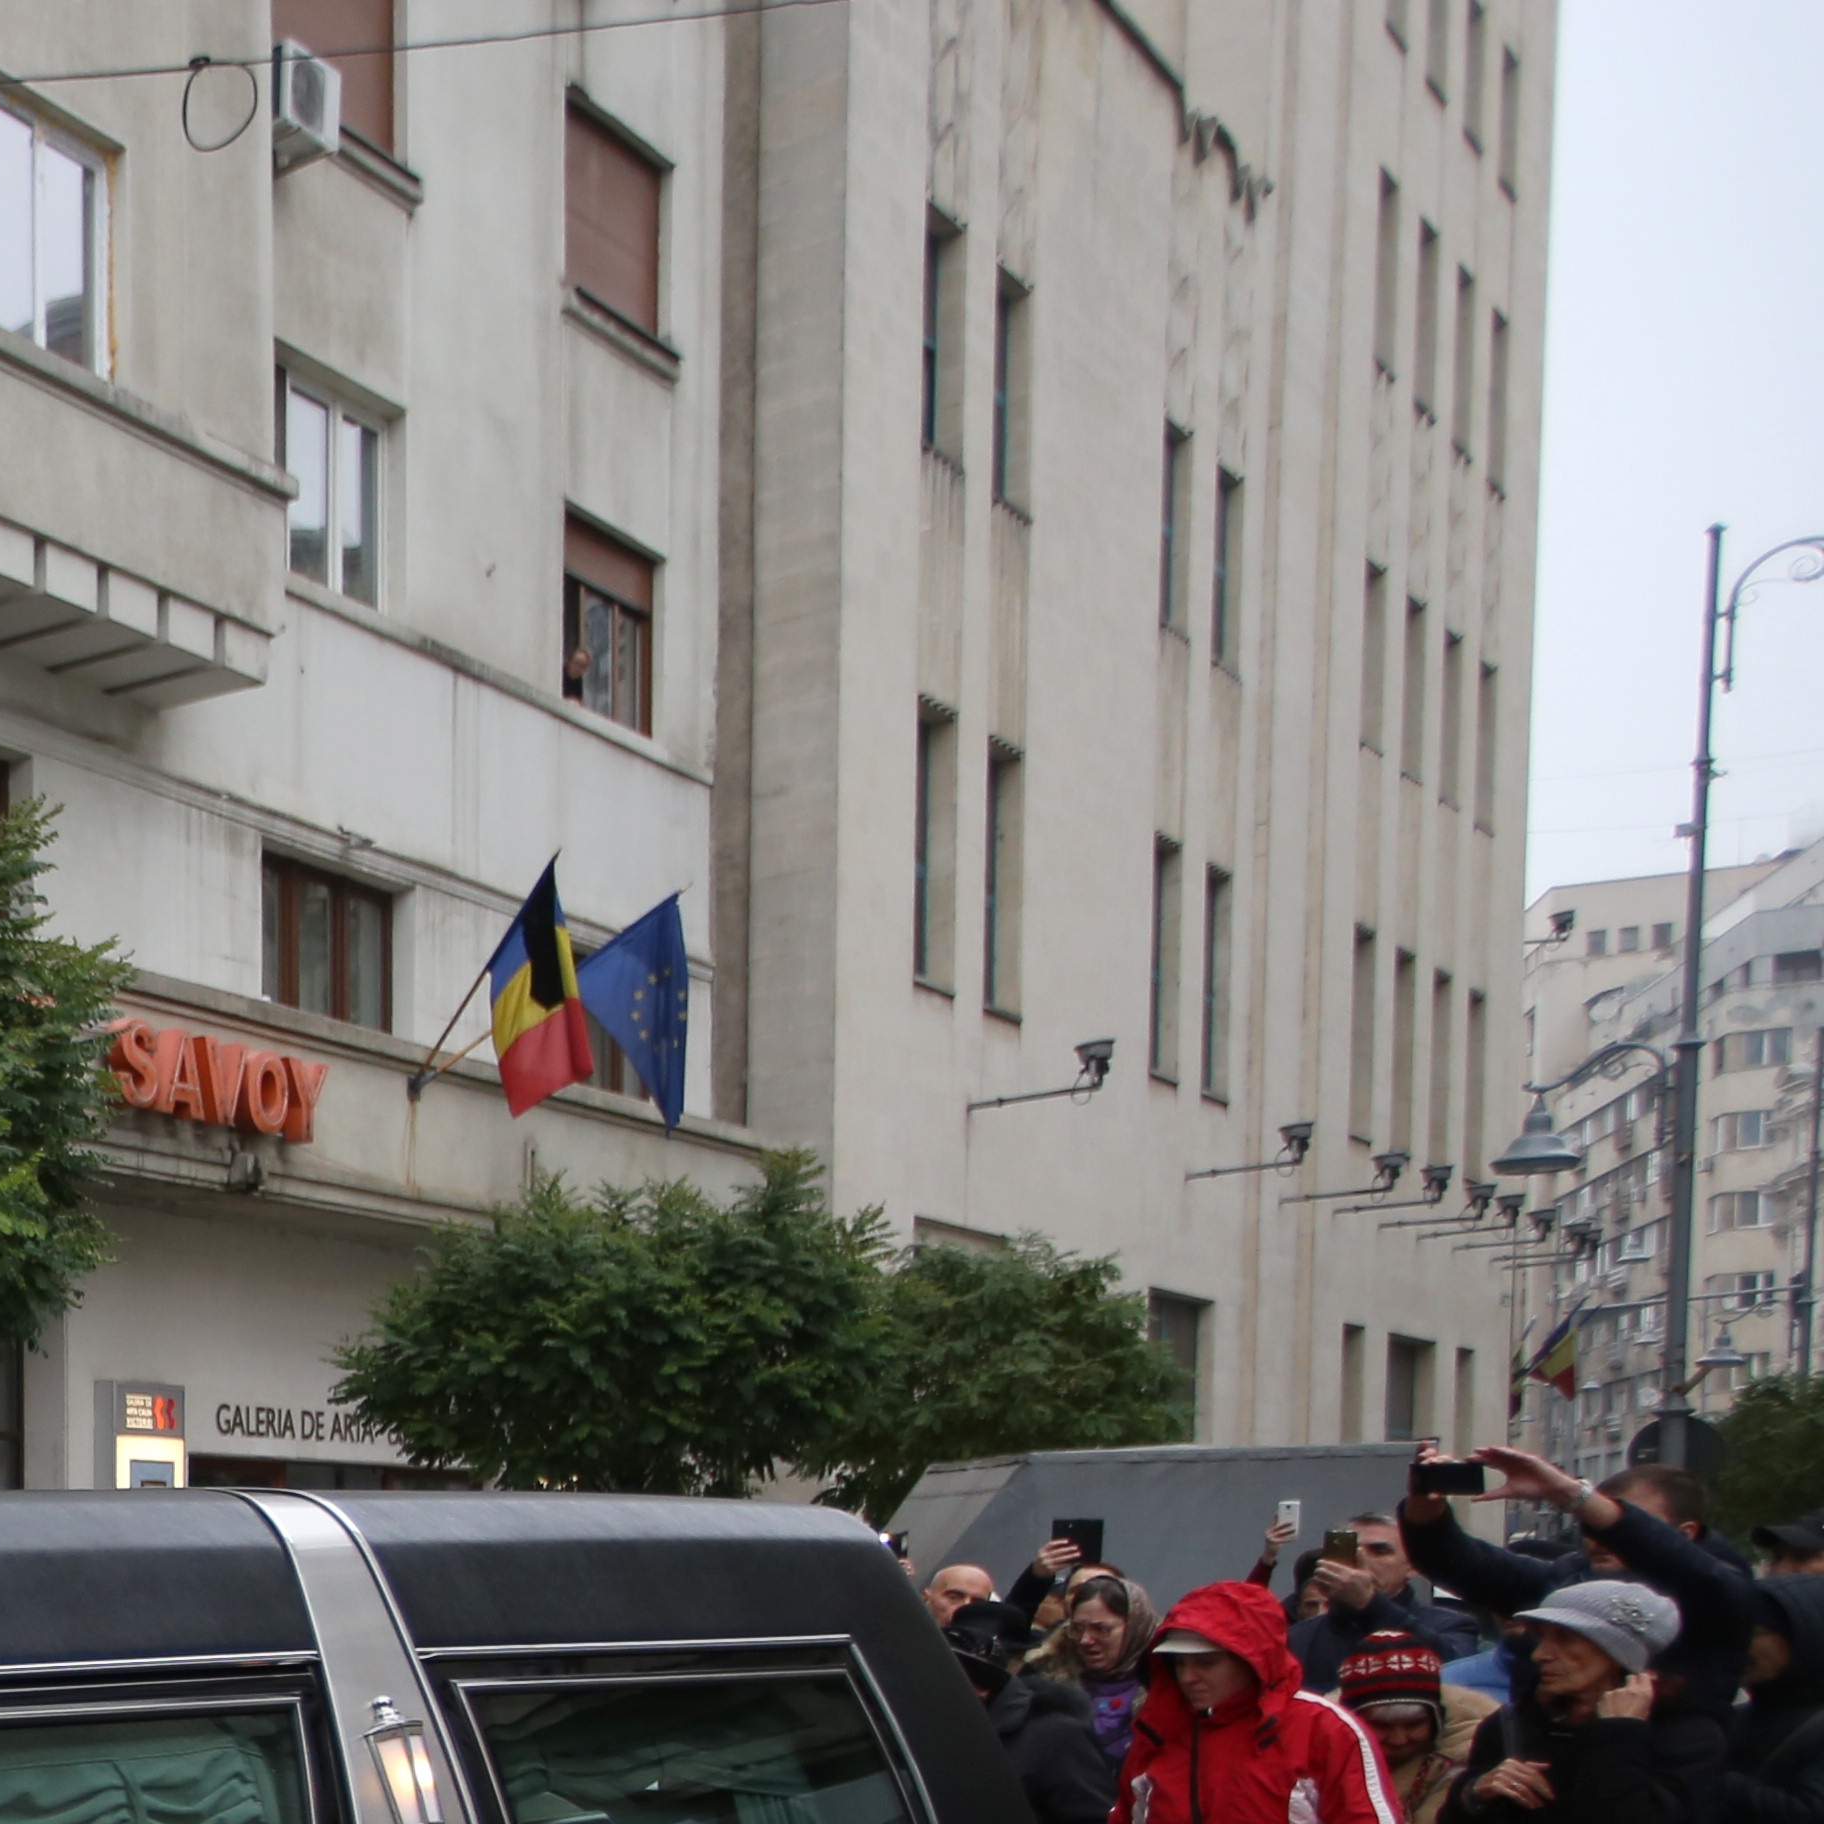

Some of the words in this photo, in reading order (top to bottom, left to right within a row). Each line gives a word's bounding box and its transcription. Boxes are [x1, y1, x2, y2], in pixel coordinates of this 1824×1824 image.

[104, 1018, 329, 1144] SAVOY
[216, 1403, 296, 1441] GALERIA
[300, 1410, 326, 1442] DE
